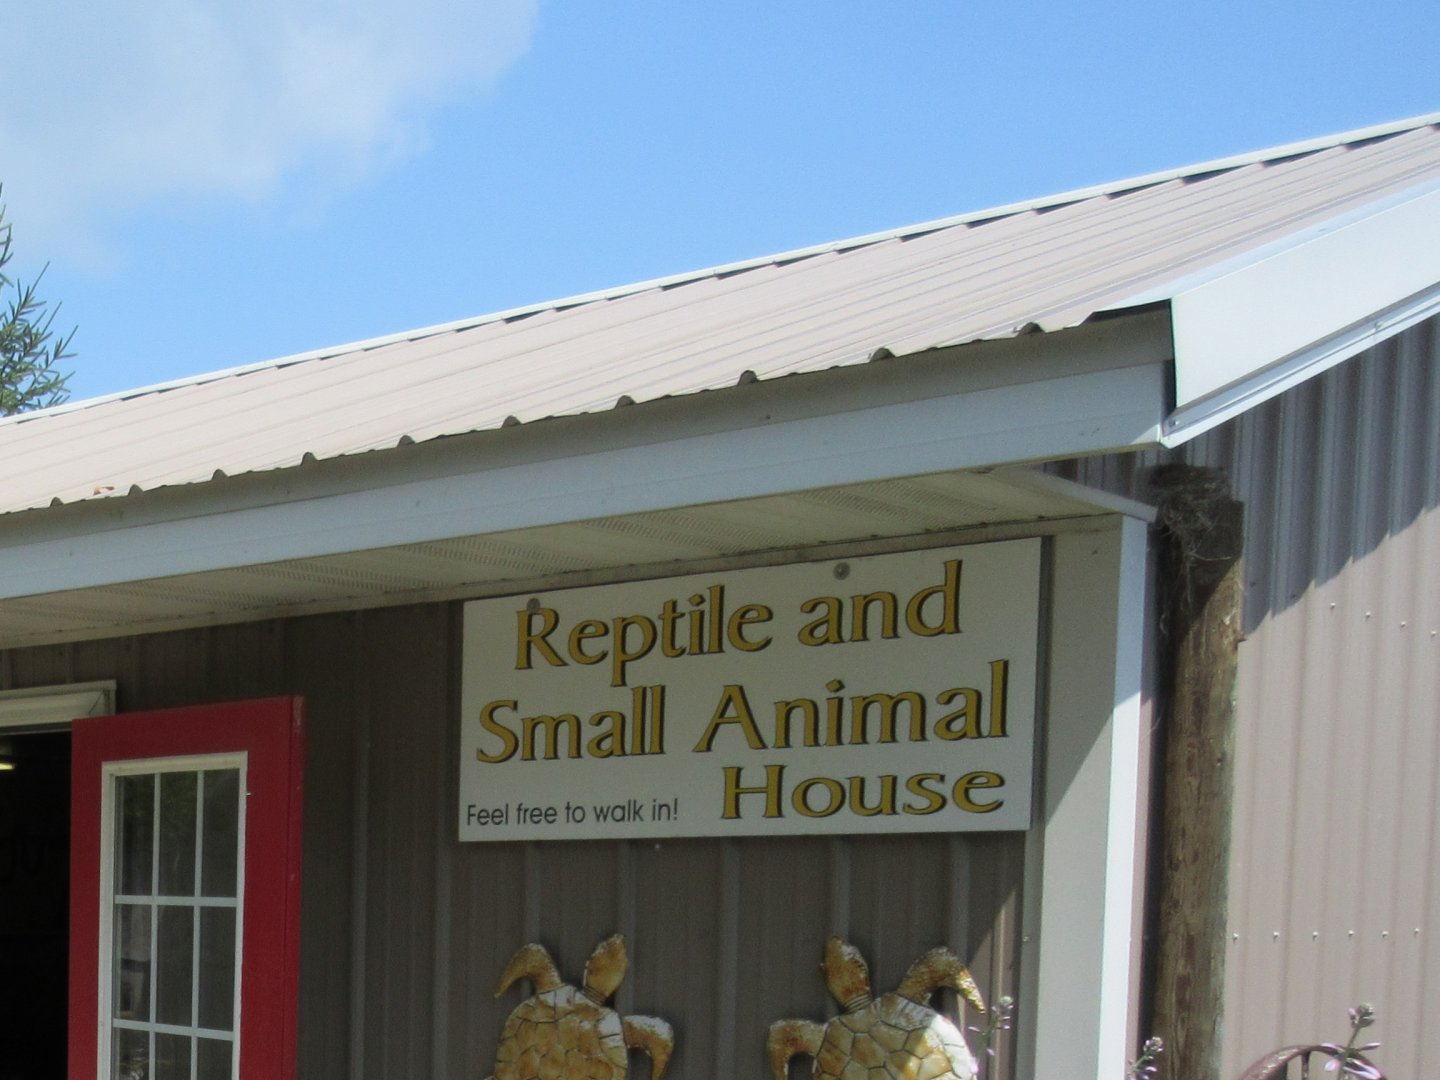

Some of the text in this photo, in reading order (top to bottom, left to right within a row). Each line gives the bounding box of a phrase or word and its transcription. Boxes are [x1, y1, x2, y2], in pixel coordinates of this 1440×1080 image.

[515, 560, 963, 687] Reptile and
[476, 659, 1009, 763] Small Animal
[467, 798, 678, 826] Feel free to walk in!
[721, 764, 1006, 819] House
